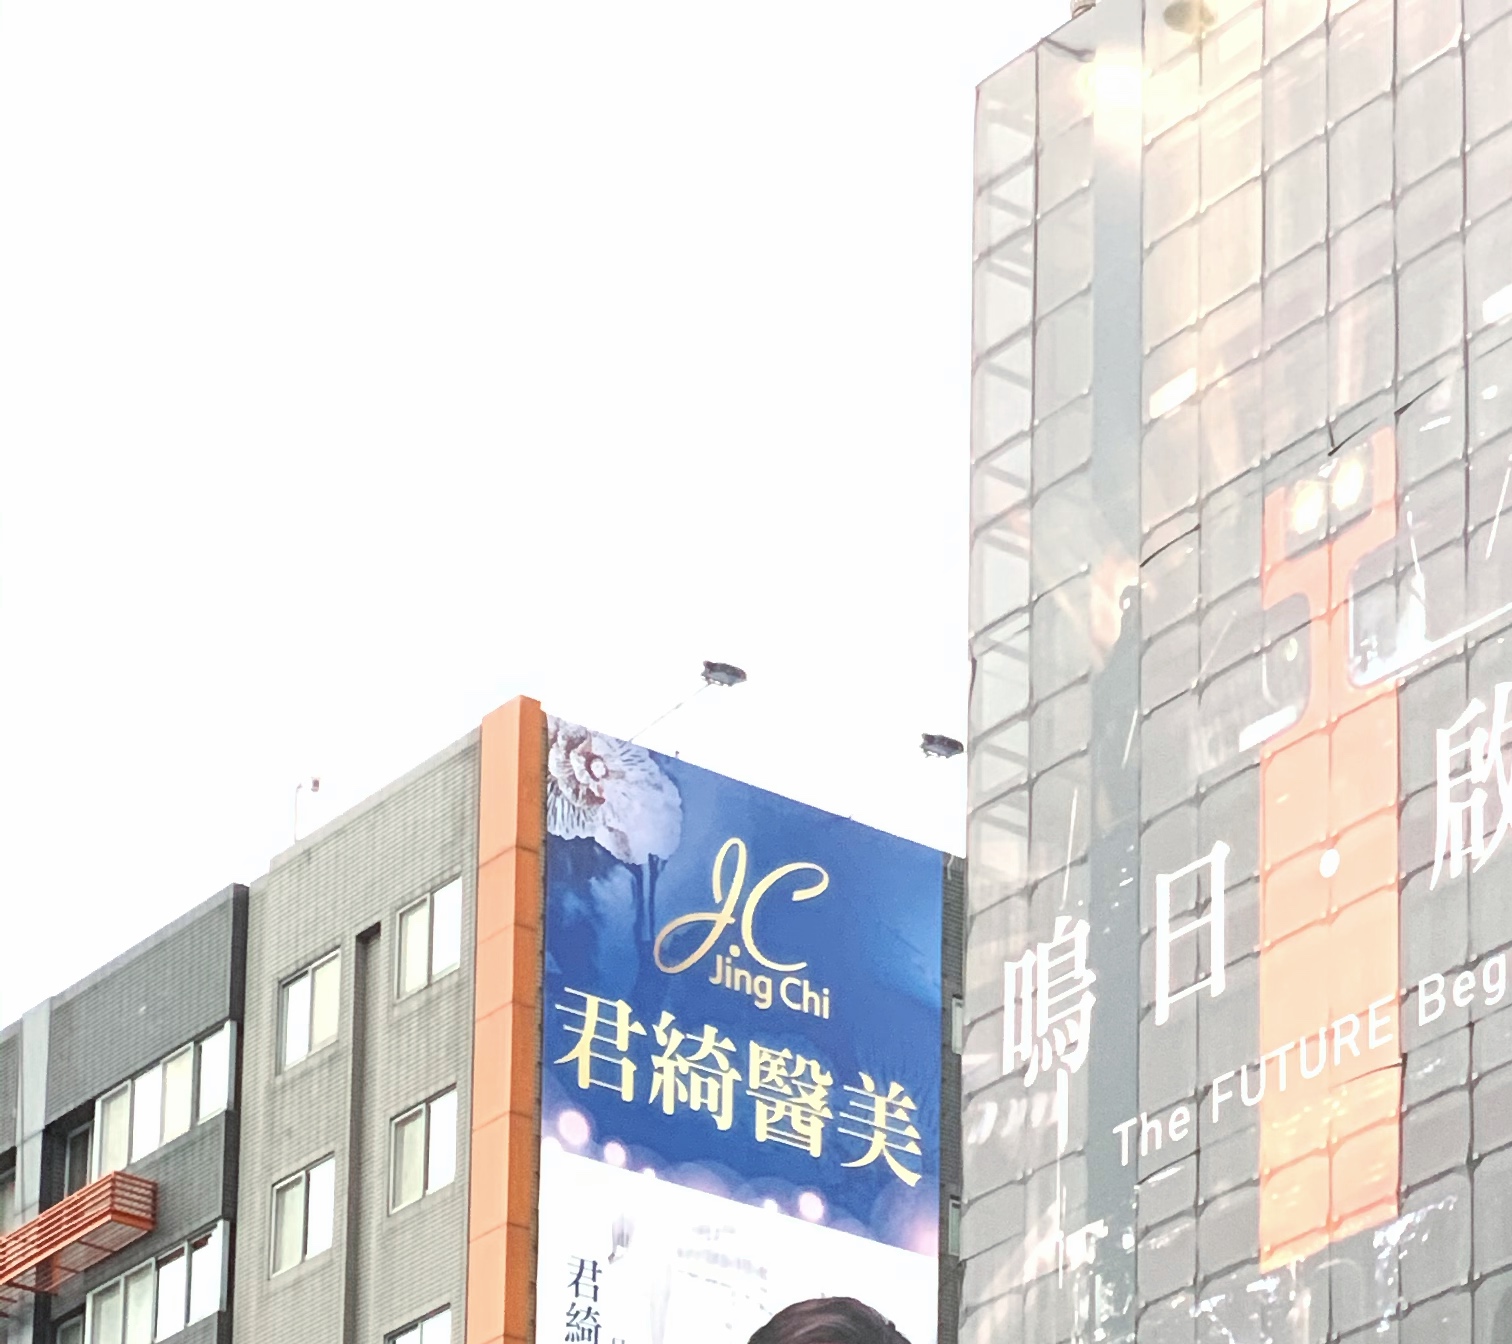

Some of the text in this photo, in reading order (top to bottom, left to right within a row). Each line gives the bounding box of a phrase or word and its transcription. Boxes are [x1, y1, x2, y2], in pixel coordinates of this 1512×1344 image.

[709, 953, 831, 1020] Jing Chi
[553, 986, 923, 1188] 君綺醫美
[1113, 1105, 1190, 1167] The
[1210, 995, 1396, 1123] FUTURE
